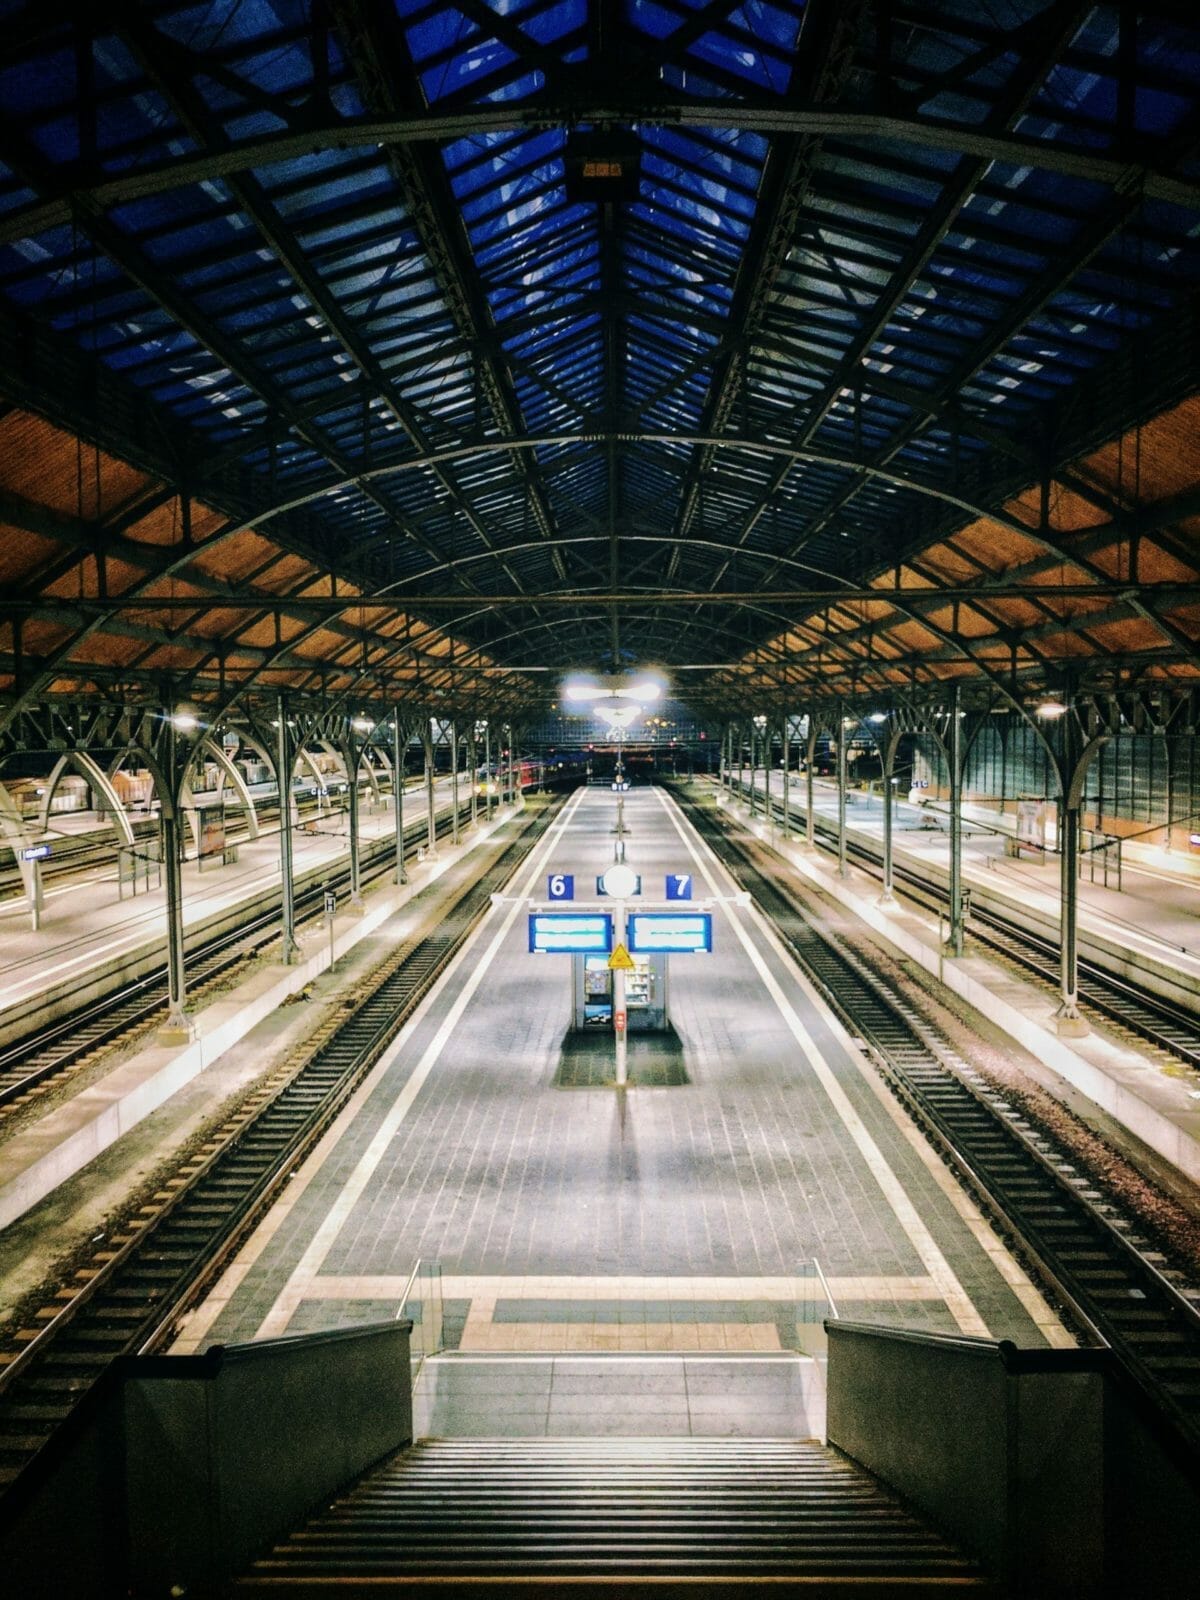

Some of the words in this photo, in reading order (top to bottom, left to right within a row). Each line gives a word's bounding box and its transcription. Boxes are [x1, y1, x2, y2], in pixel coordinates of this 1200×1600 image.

[551, 875, 566, 896] 6
[674, 875, 690, 896] 7
[326, 898, 334, 911] H
[961, 897, 969, 910] H
